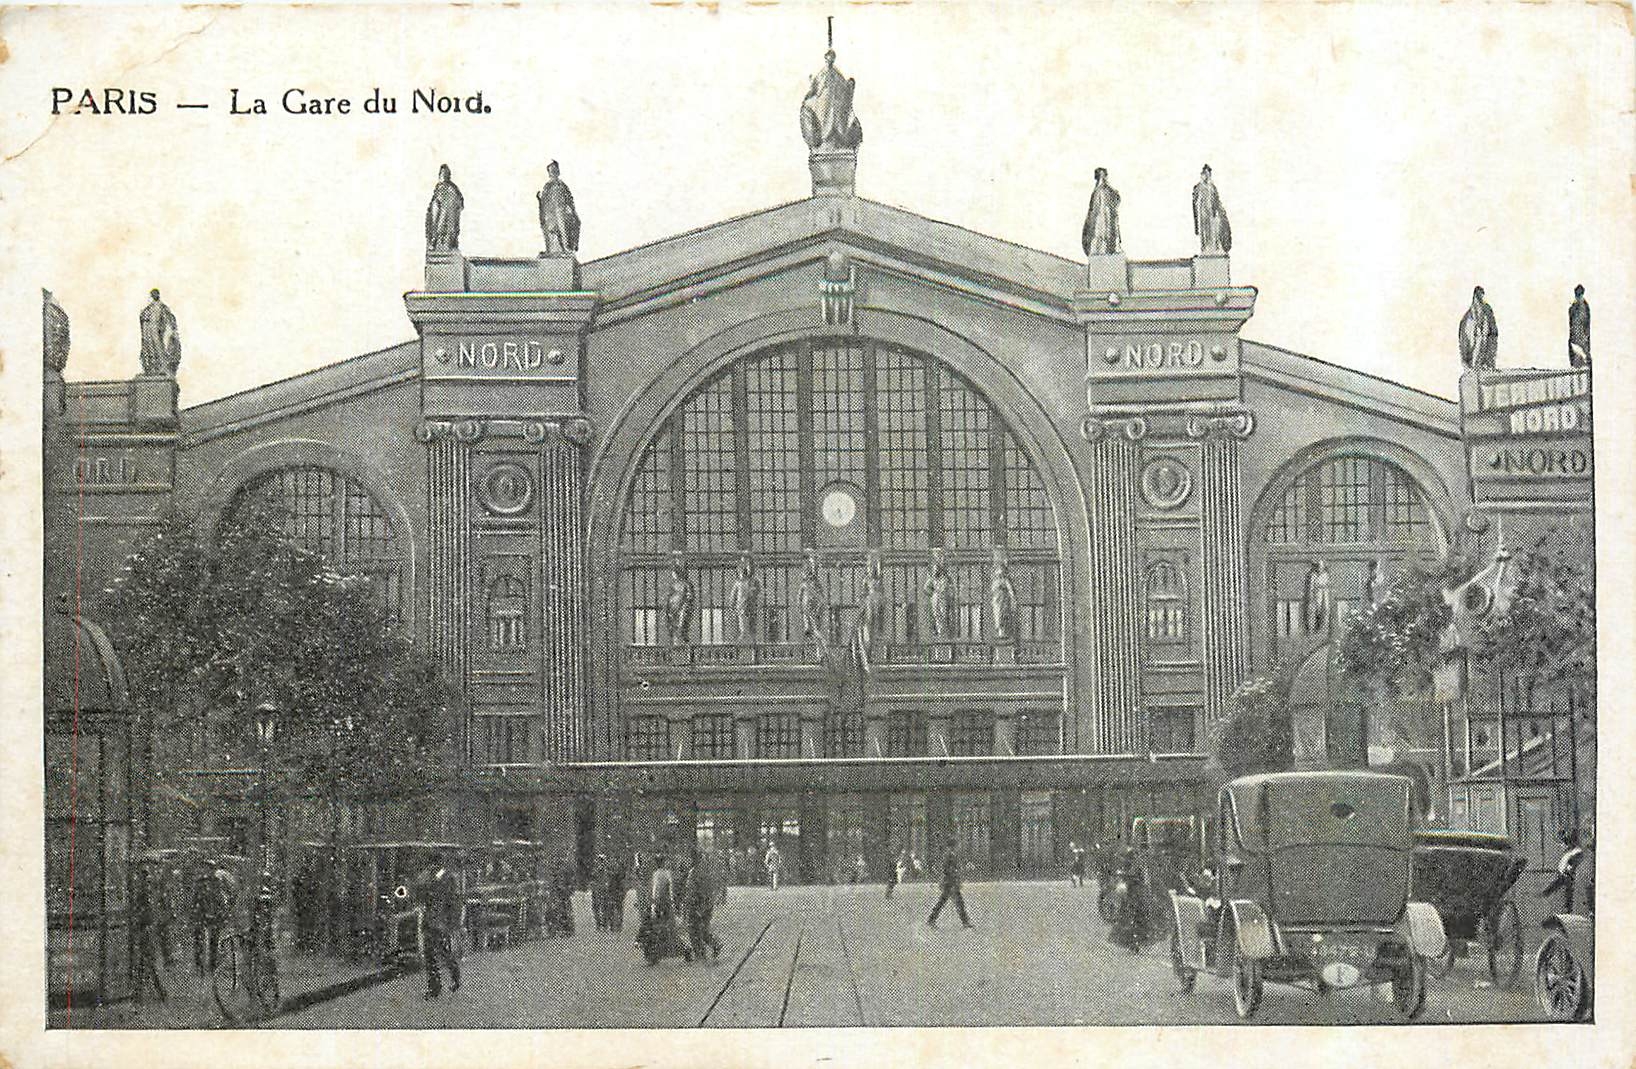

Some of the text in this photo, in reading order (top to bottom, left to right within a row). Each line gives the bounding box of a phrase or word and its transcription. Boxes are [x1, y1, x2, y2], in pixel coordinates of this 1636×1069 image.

[458, 341, 542, 372] NORD
[1125, 340, 1204, 369] NORD
[1510, 404, 1578, 434] NORD
[1503, 448, 1587, 475] NORD
